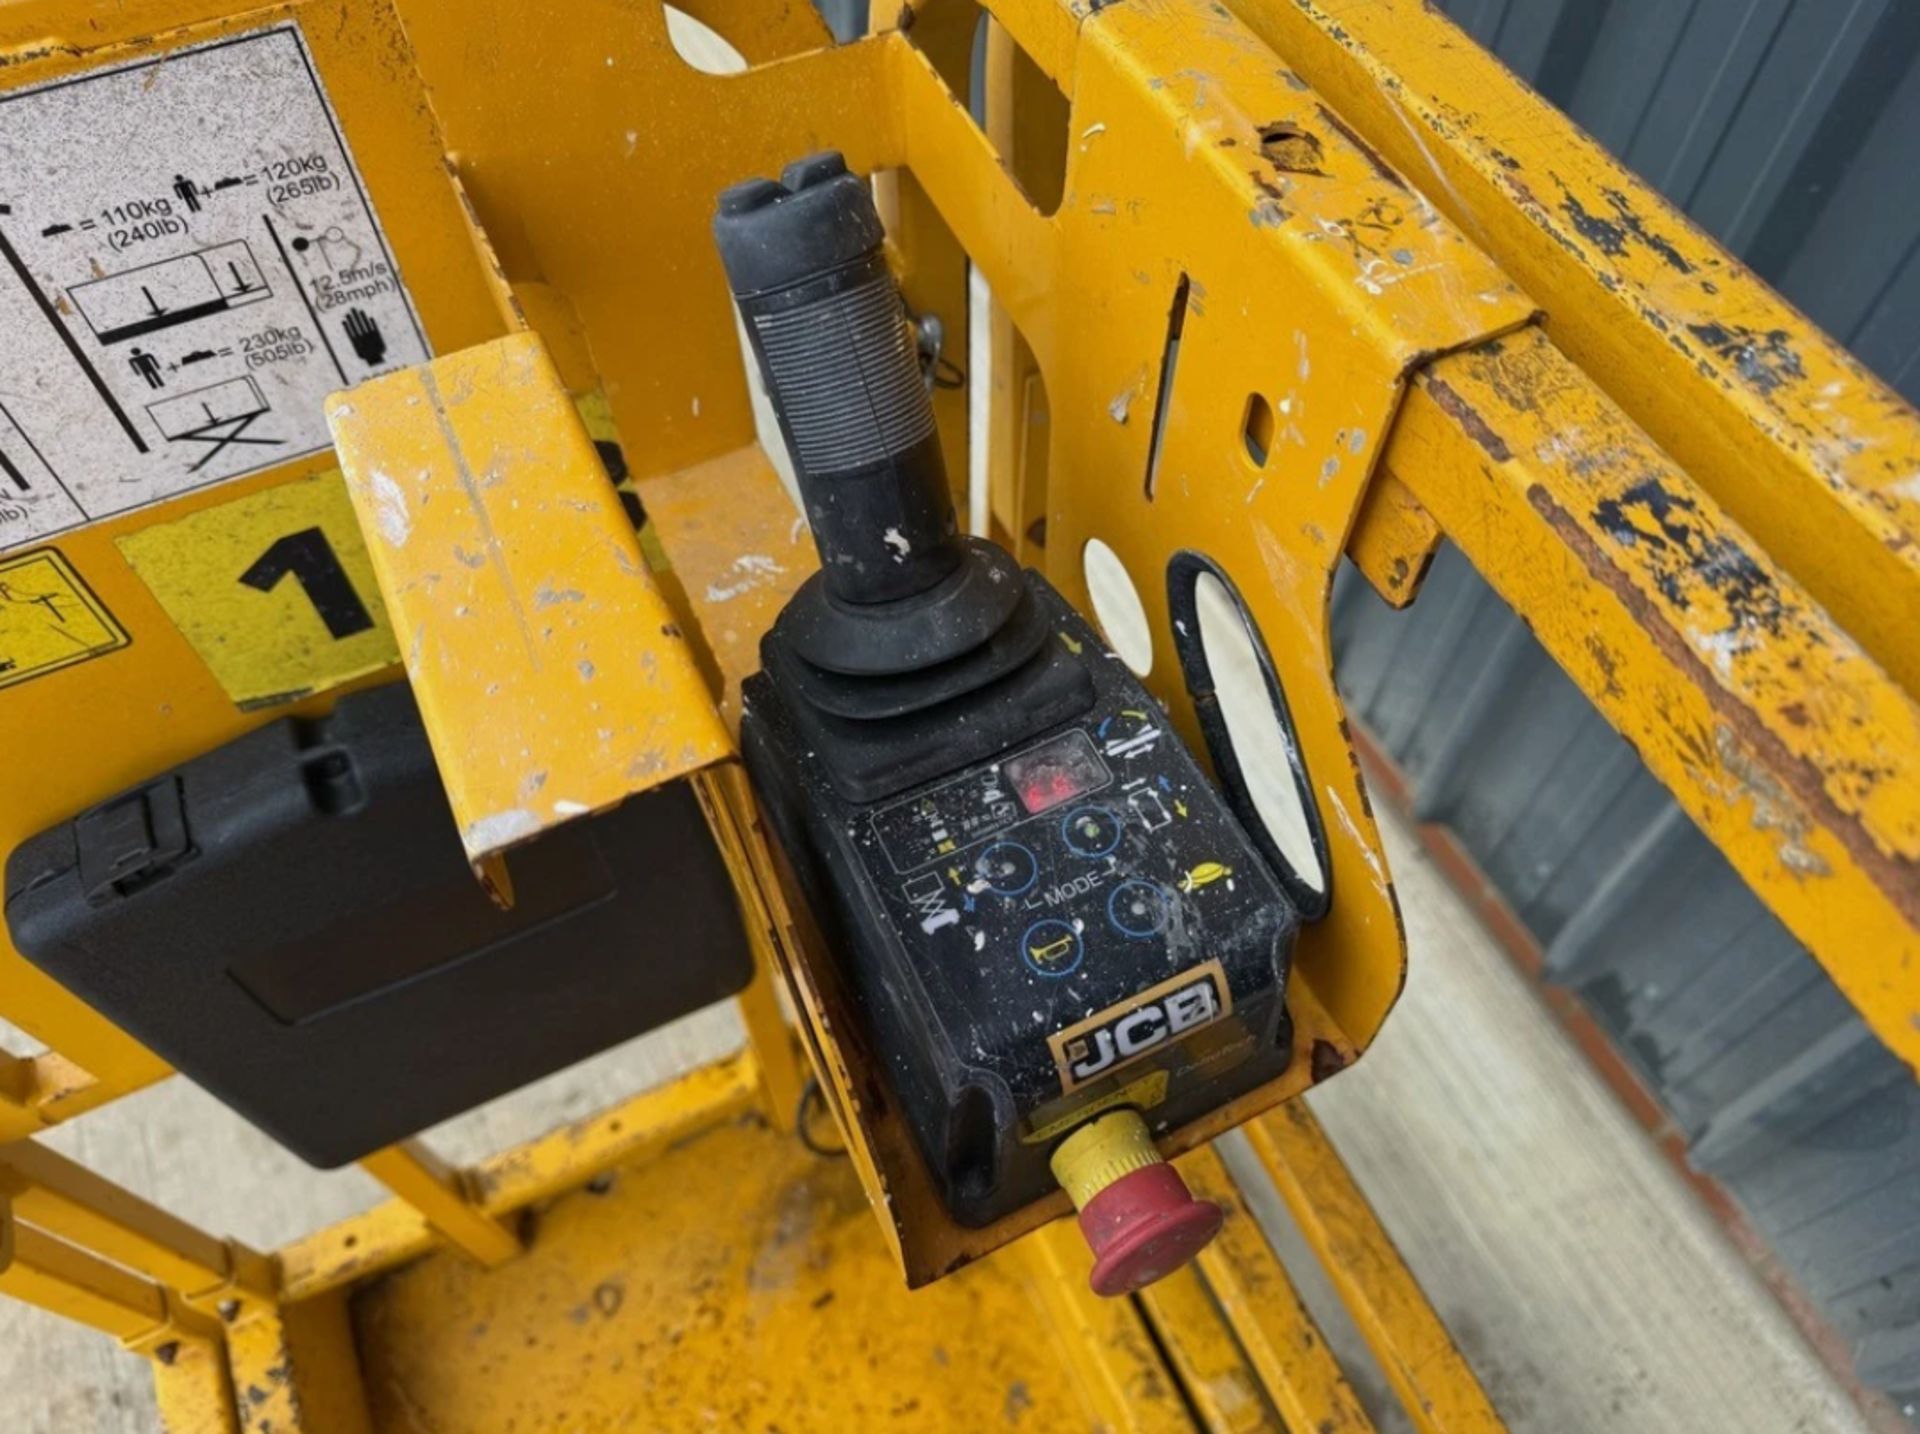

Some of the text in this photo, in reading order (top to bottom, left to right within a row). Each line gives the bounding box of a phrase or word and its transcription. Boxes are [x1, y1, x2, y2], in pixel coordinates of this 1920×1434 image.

[262, 155, 328, 182] 120kg
[267, 172, 340, 206] (265lb)
[102, 198, 172, 226] 110kg
[108, 215, 189, 252] (240lb)
[310, 262, 387, 292] 12.5m/s
[315, 277, 396, 313] (28mph)
[239, 326, 302, 352] 230kg
[245, 338, 315, 370] (505lb)
[238, 526, 375, 641] 1
[1044, 871, 1103, 907] MODE
[1073, 981, 1220, 1078] JCB
